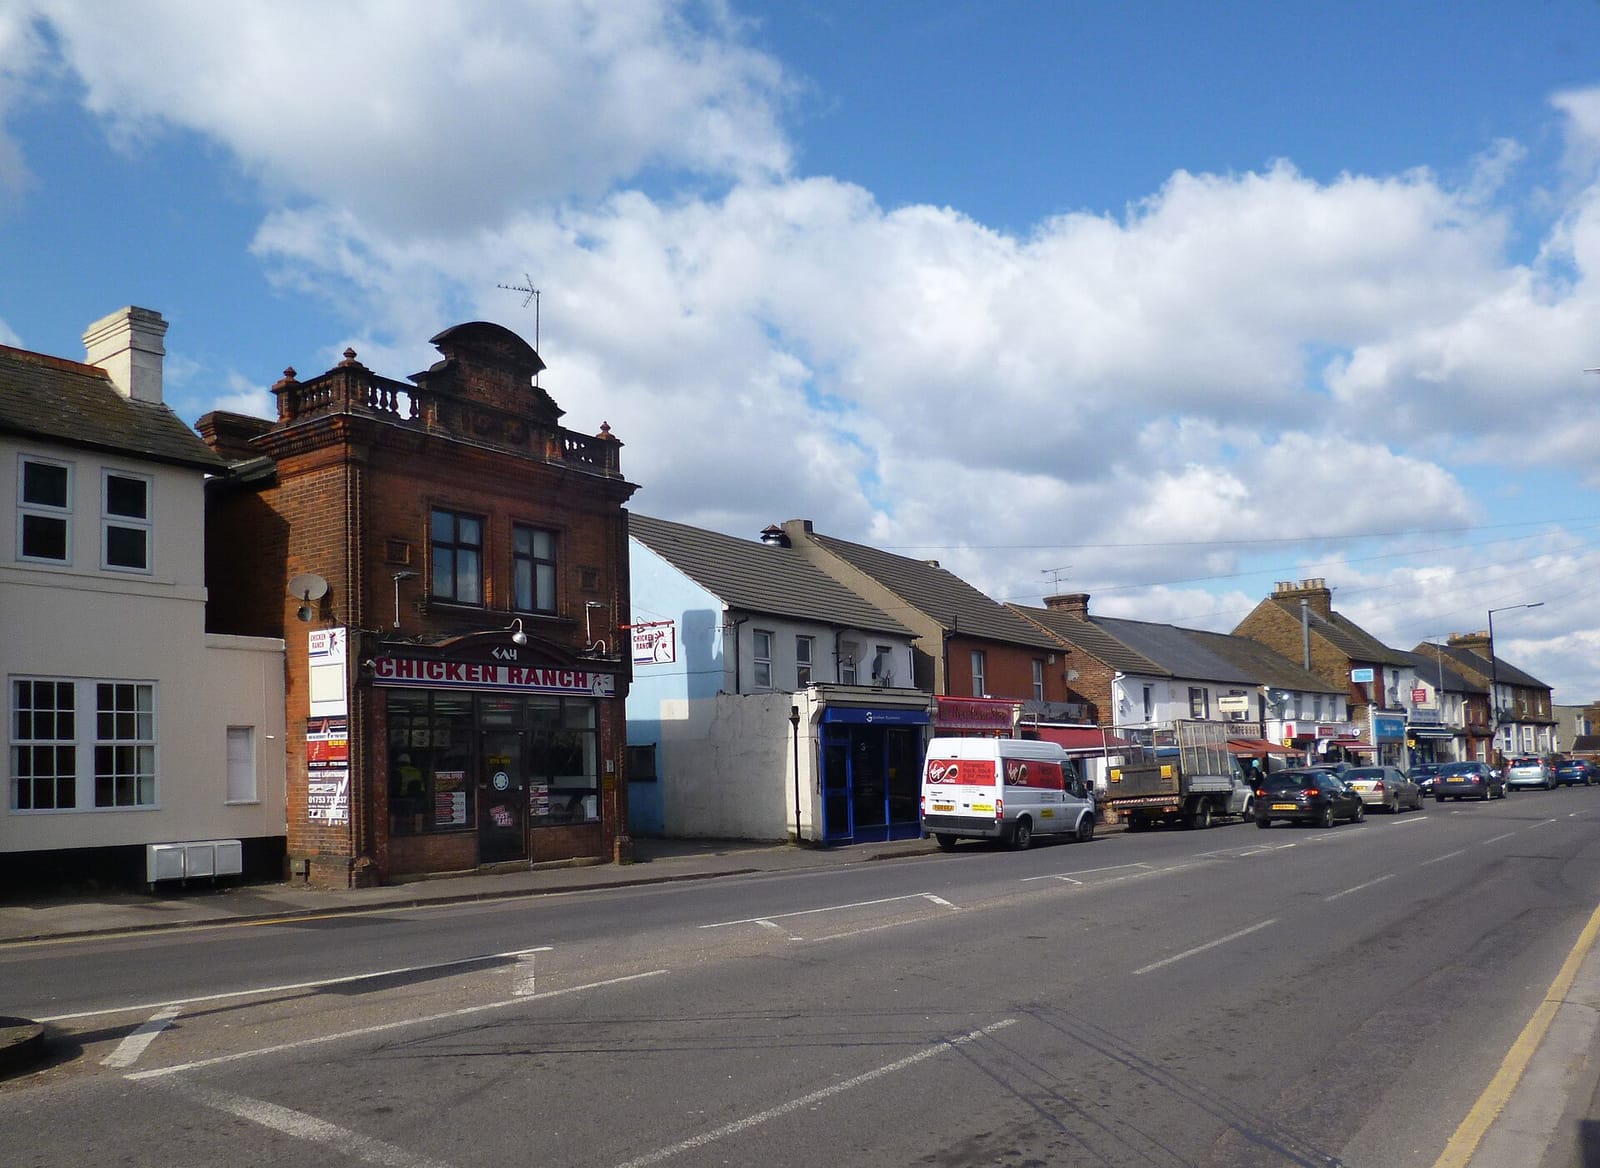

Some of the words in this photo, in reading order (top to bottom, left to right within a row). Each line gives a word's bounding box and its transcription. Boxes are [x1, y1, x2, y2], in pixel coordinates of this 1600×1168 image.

[633, 634, 654, 643] CHICKEN
[636, 642, 653, 650] RANCH
[375, 657, 498, 683] CHICKEN
[507, 664, 588, 688] RANCH
